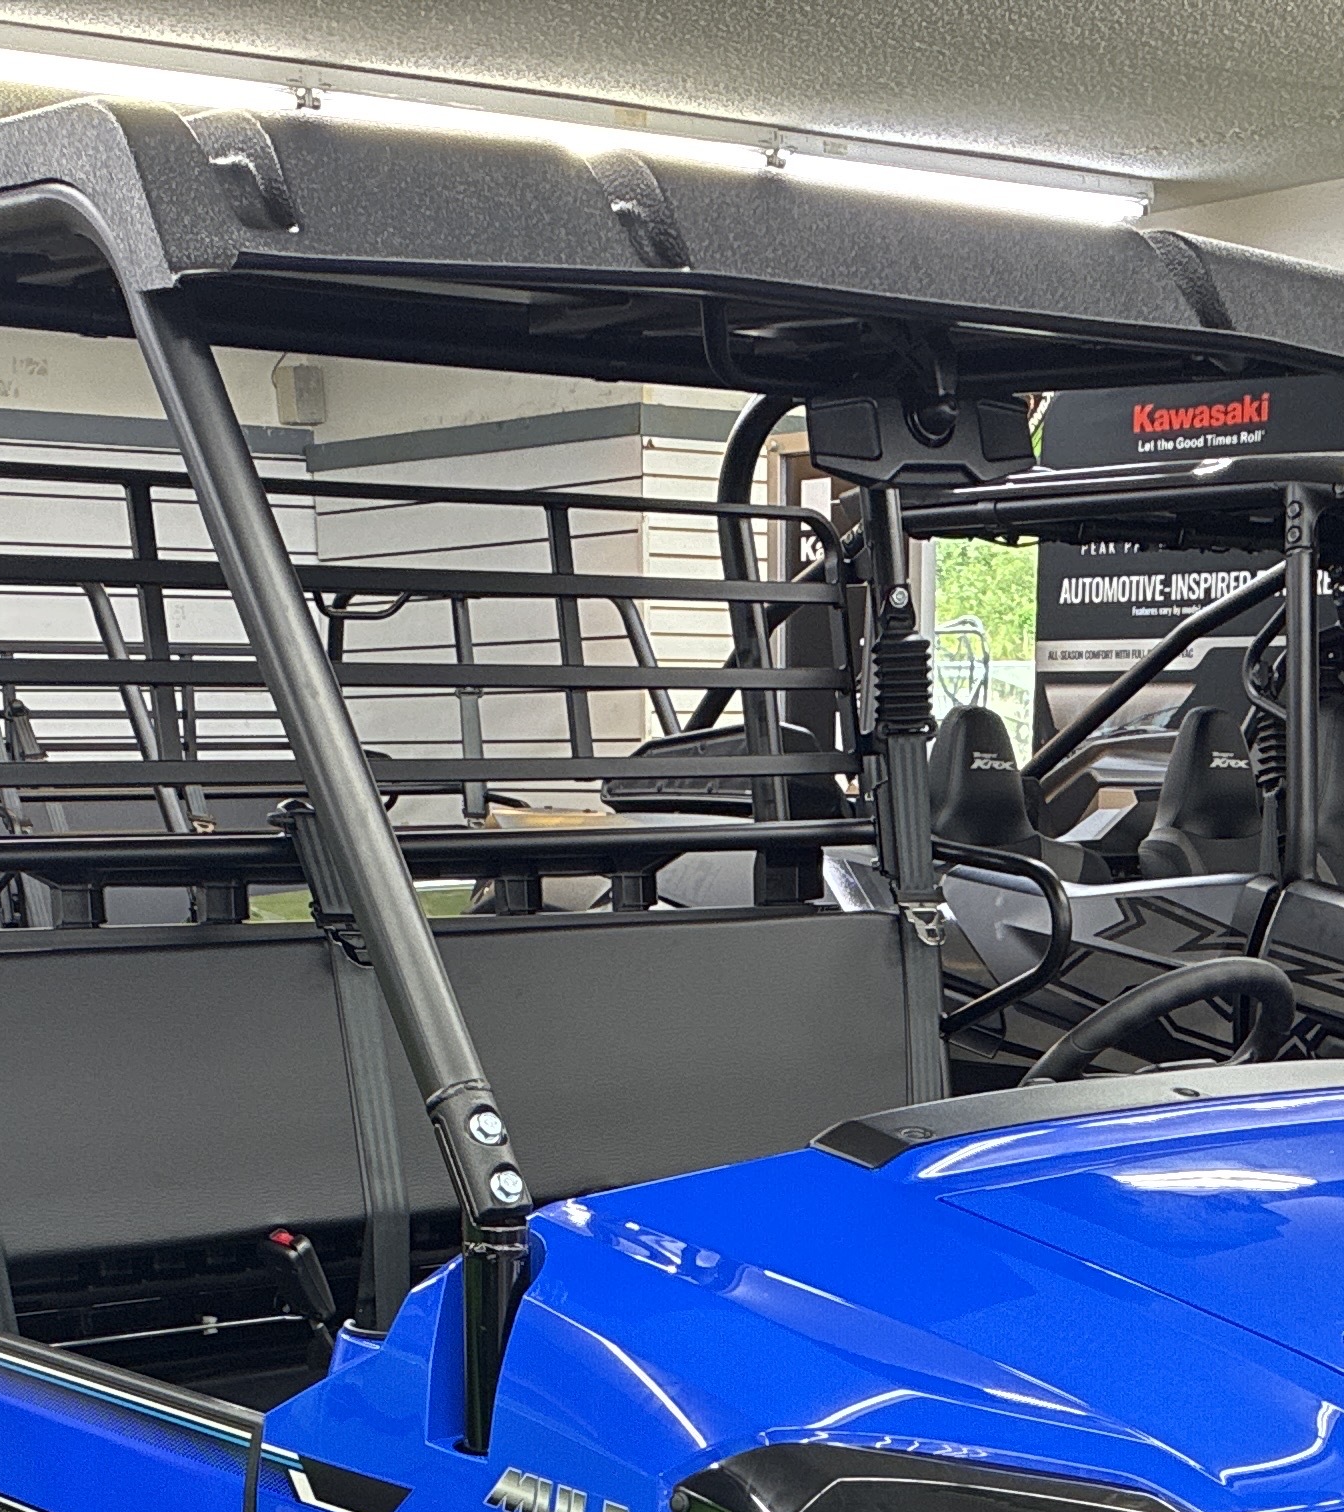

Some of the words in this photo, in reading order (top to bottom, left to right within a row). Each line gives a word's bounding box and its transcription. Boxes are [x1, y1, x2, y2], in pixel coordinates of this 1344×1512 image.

[1133, 392, 1270, 433] Kawasaki
[1138, 440, 1155, 453] Let
[1157, 438, 1174, 451] the
[1176, 434, 1205, 450] Good
[1206, 433, 1238, 447] Times
